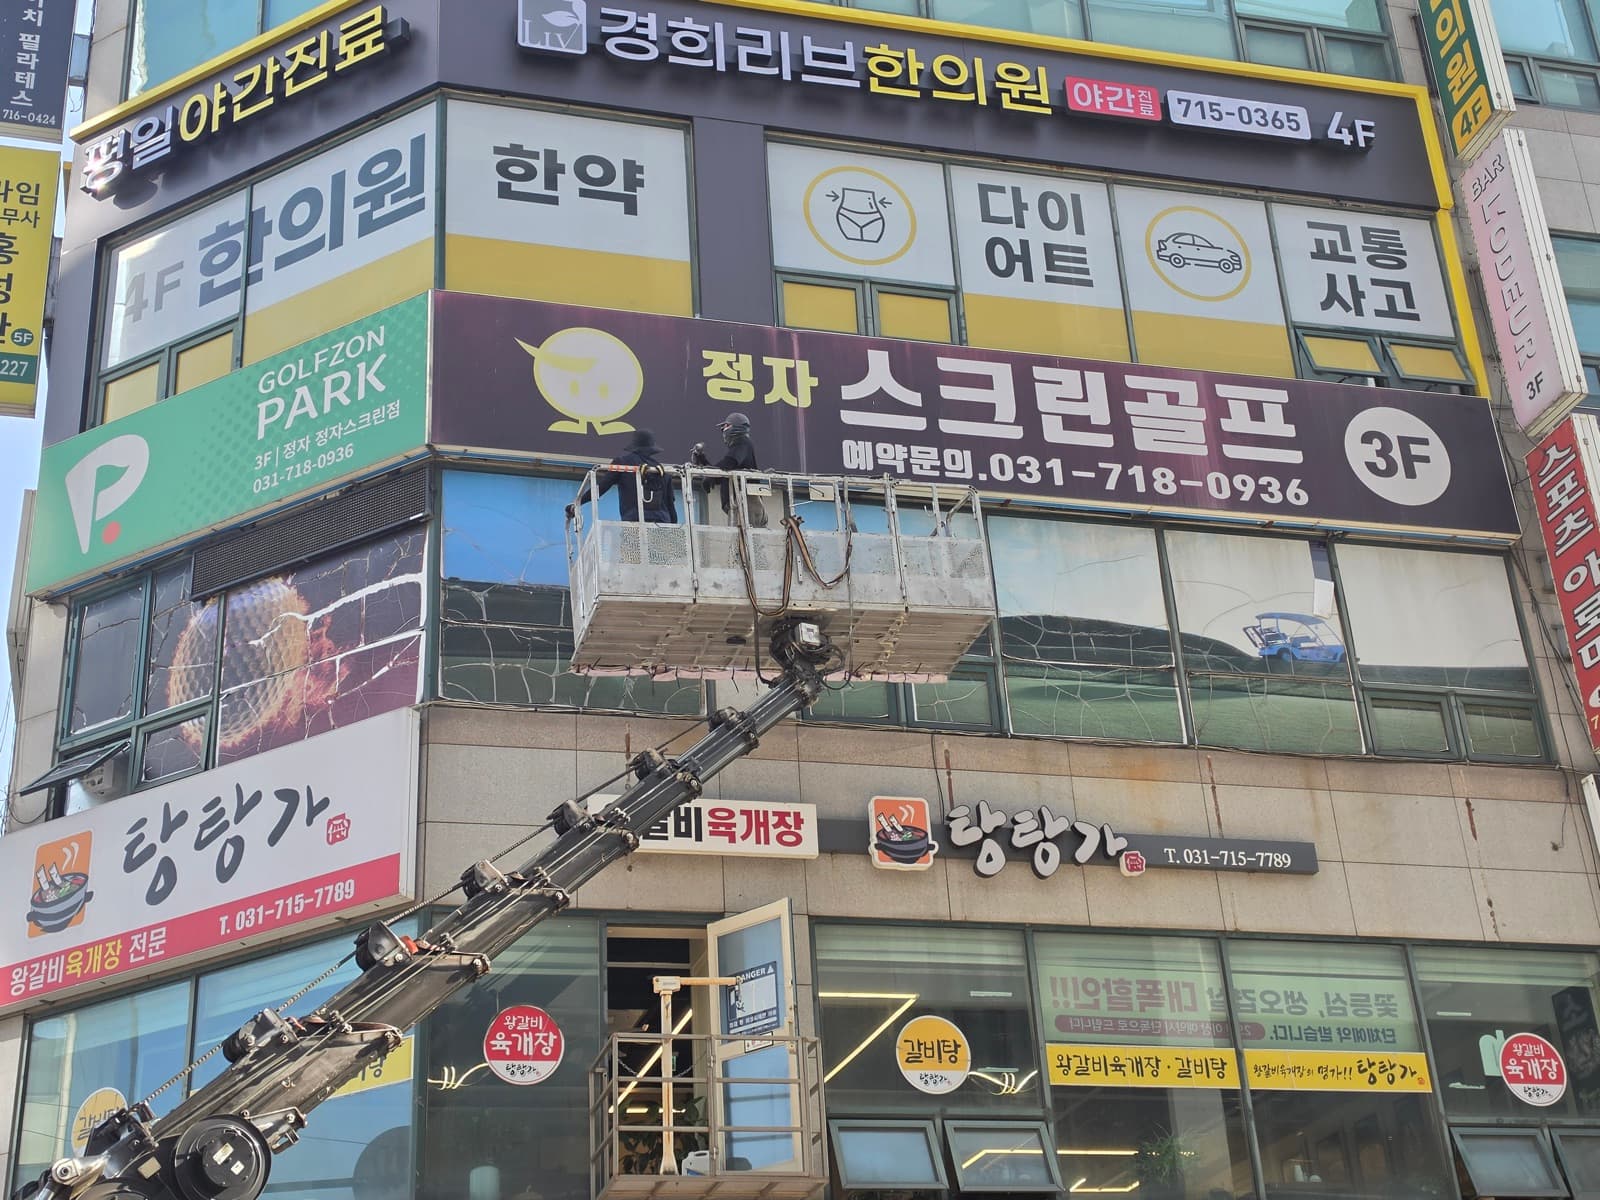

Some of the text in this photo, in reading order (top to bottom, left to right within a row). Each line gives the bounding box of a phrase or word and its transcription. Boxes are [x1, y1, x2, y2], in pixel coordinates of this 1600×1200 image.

[523, 19, 580, 50] LIV
[1430, 0, 1479, 105] 의원
[10, 33, 40, 107] 필라테스
[2, 109, 57, 125] 716-0424
[1073, 82, 1136, 114] 야간
[1176, 98, 1301, 132] 715-0365
[1327, 111, 1376, 148] 4F
[1461, 98, 1483, 138] 4F
[492, 142, 645, 216] 한약
[1471, 153, 1505, 202] BAR
[125, 260, 185, 324] 4F
[198, 132, 427, 308] 한의원
[977, 182, 1086, 236] 다이
[984, 236, 1094, 288] 어트
[1306, 220, 1408, 271] 교통
[1319, 272, 1421, 322] 사고
[13, 331, 33, 343] 5F
[258, 325, 385, 394] GOLFZON
[257, 353, 387, 440] PARK
[1526, 372, 1544, 401] 3F
[254, 399, 401, 471] 3F 정자 정자스크린점
[702, 349, 1431, 480] 정자 스크린골프 3F
[252, 443, 354, 493] 031-718-0936
[1538, 444, 1594, 558] 스포츠
[122, 782, 331, 906] 탕탕가
[946, 799, 1128, 879] 탕탕가
[1164, 848, 1182, 864] T.
[1184, 849, 1292, 869] 031-715-7789
[219, 879, 355, 936] T. 031-715-7789
[10, 927, 167, 997] 왕갈비육개장 전문
[489, 1032, 557, 1056] 육개장
[503, 1015, 543, 1030] 왕갈비
[903, 1038, 962, 1064] 갈비탕
[1356, 1057, 1417, 1085] 탕탕가
[1505, 1057, 1559, 1080] 육개장
[1512, 1042, 1545, 1057] 왕갈비
